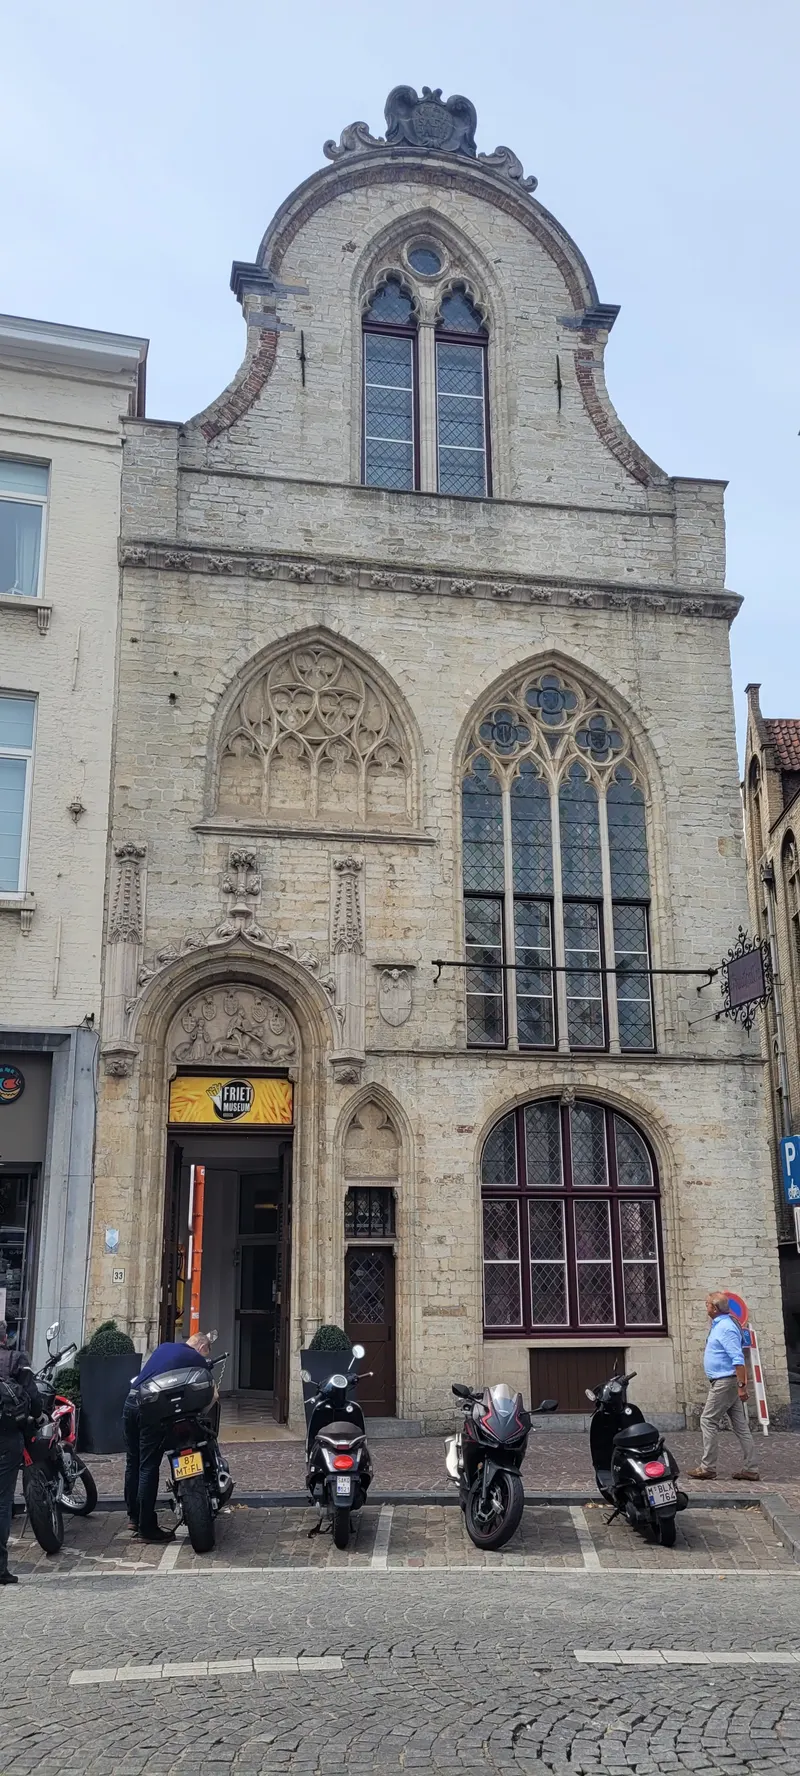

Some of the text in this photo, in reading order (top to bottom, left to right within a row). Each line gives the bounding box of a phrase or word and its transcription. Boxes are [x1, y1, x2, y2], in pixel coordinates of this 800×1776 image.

[223, 1086, 251, 1101] FRIET
[223, 1102, 251, 1112] MUSEUM
[784, 1141, 796, 1177] P
[114, 1271, 123, 1280] 33
[184, 1454, 195, 1465] 87
[660, 1491, 676, 1502] 764
